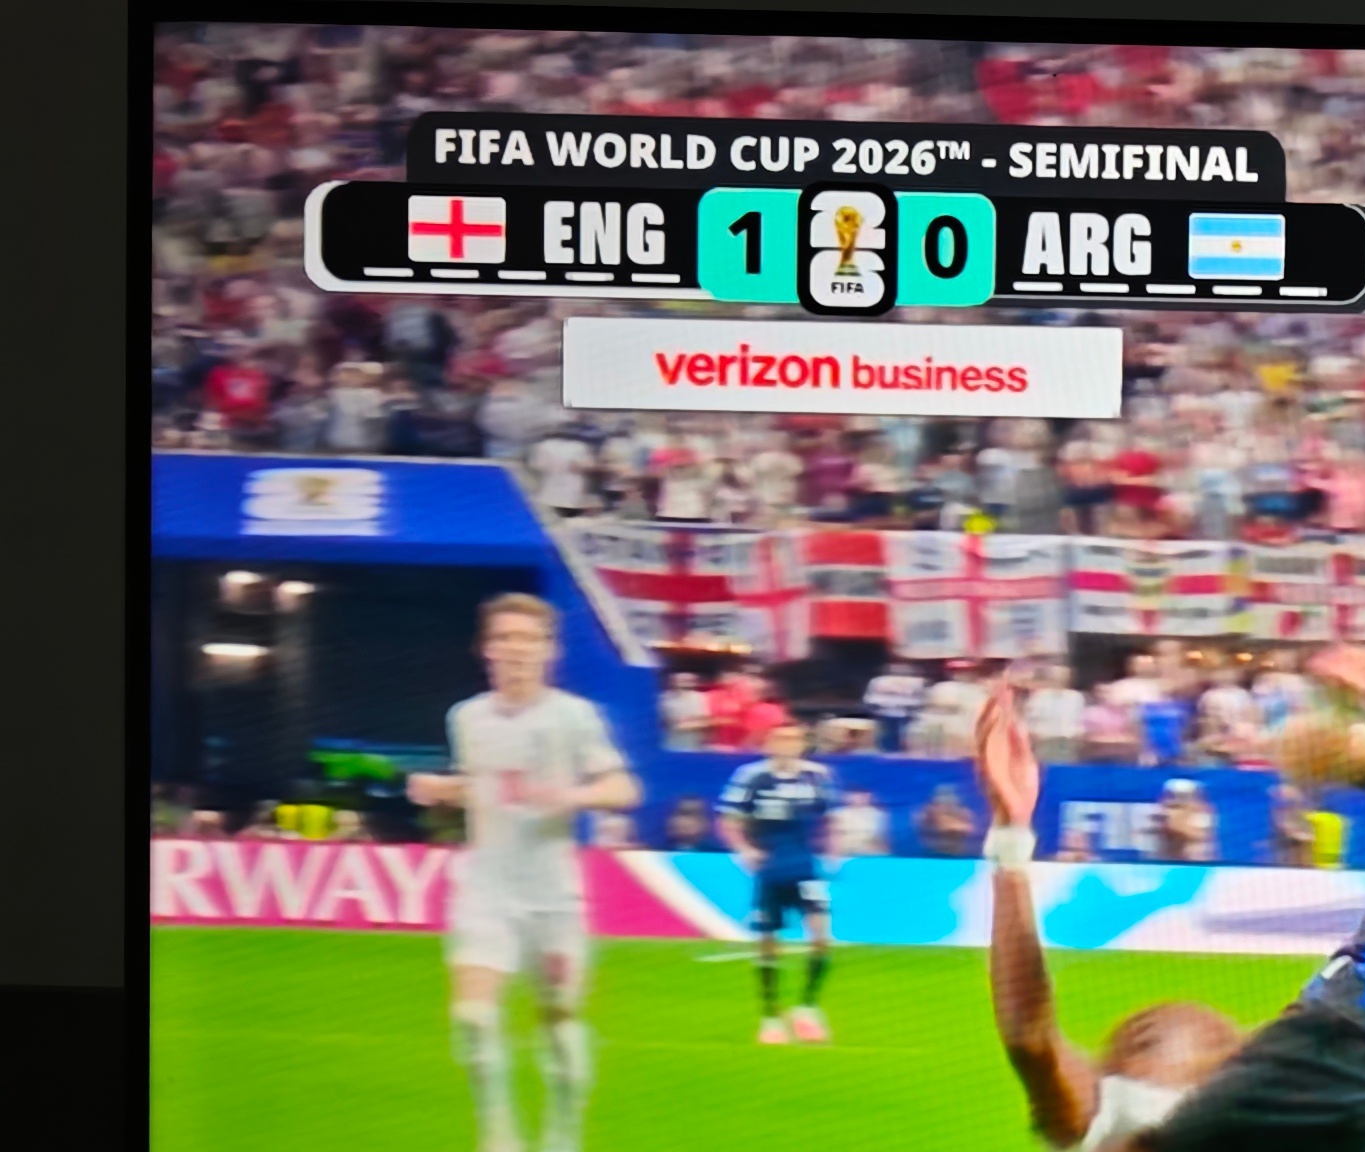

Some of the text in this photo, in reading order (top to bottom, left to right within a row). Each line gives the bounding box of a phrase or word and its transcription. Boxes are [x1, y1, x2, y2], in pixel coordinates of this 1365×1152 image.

[434, 128, 534, 166] FIFA
[546, 131, 717, 170] WORLD
[730, 136, 820, 172] CUP
[1008, 141, 1259, 184] SEMIFINAL
[543, 200, 666, 266] ENG
[728, 211, 762, 275] 1
[924, 214, 968, 279] 0
[1021, 211, 1152, 276] ARG
[830, 281, 865, 296] FIFA
[654, 343, 1028, 393] verizon business
